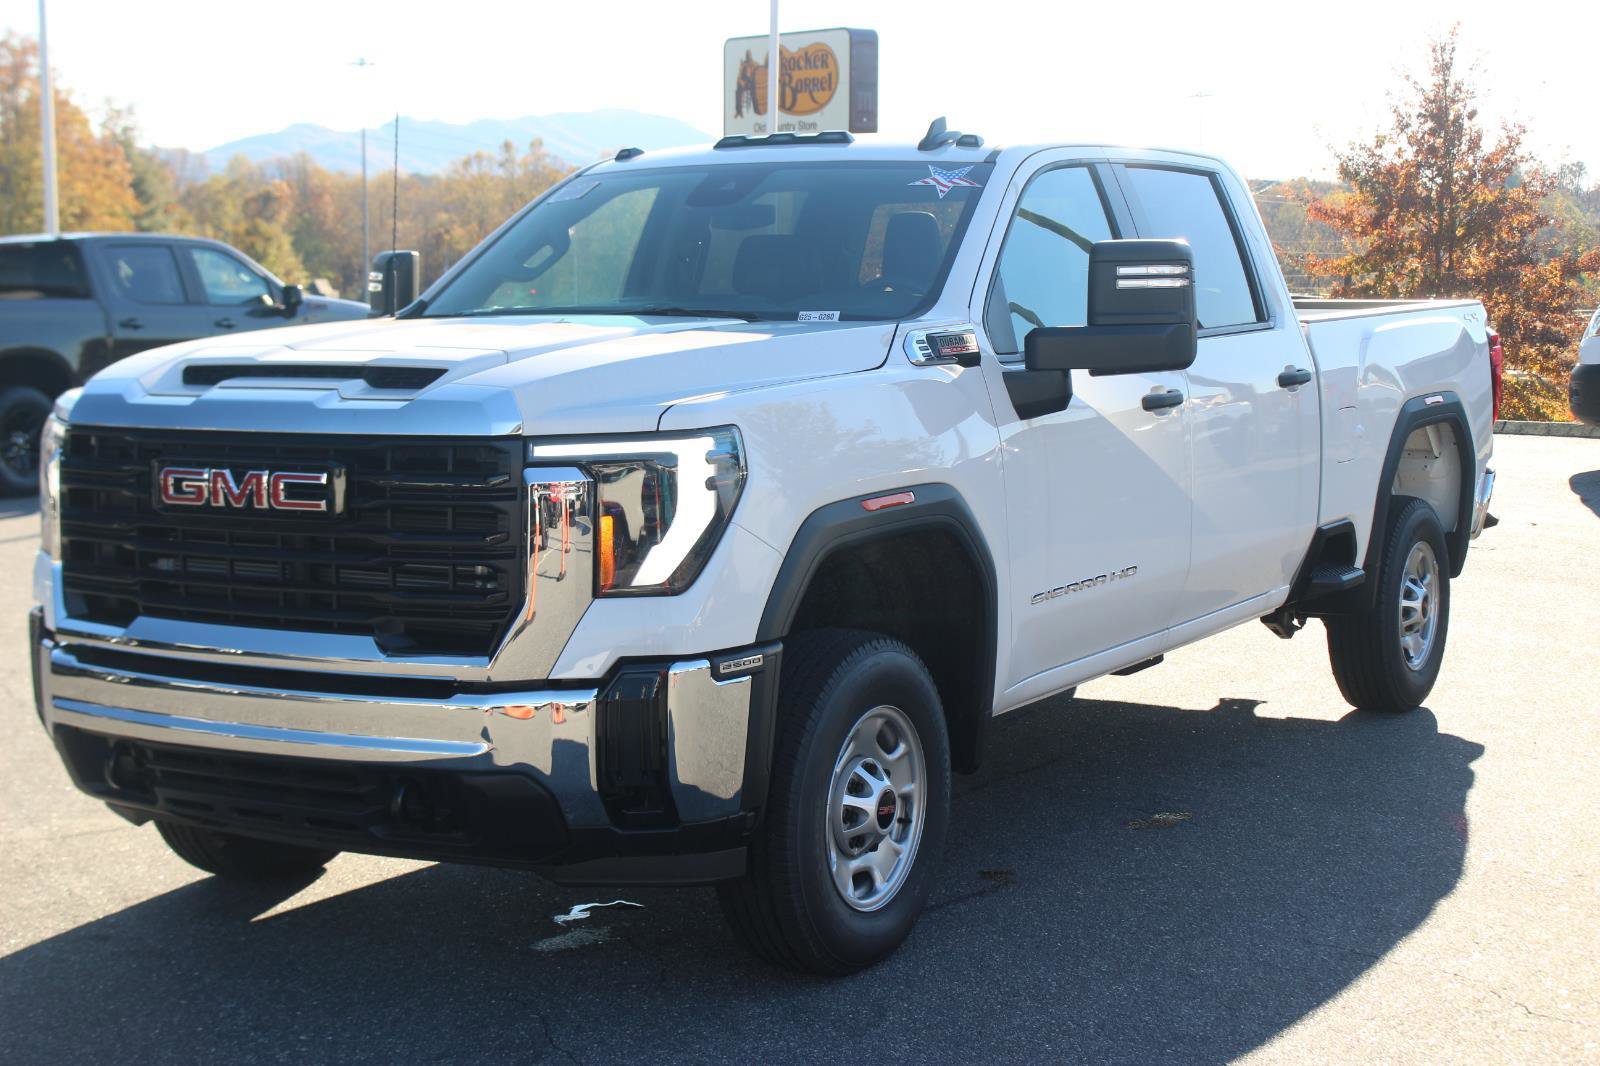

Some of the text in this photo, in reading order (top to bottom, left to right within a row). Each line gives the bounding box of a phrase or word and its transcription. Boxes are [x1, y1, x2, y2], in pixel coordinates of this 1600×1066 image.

[779, 72, 833, 112] Barrel
[798, 120, 818, 130] Store
[940, 335, 975, 347] DURAMAX
[160, 467, 328, 511] GMC
[1031, 565, 1138, 605] SIERRA HD
[722, 657, 761, 671] 2500
